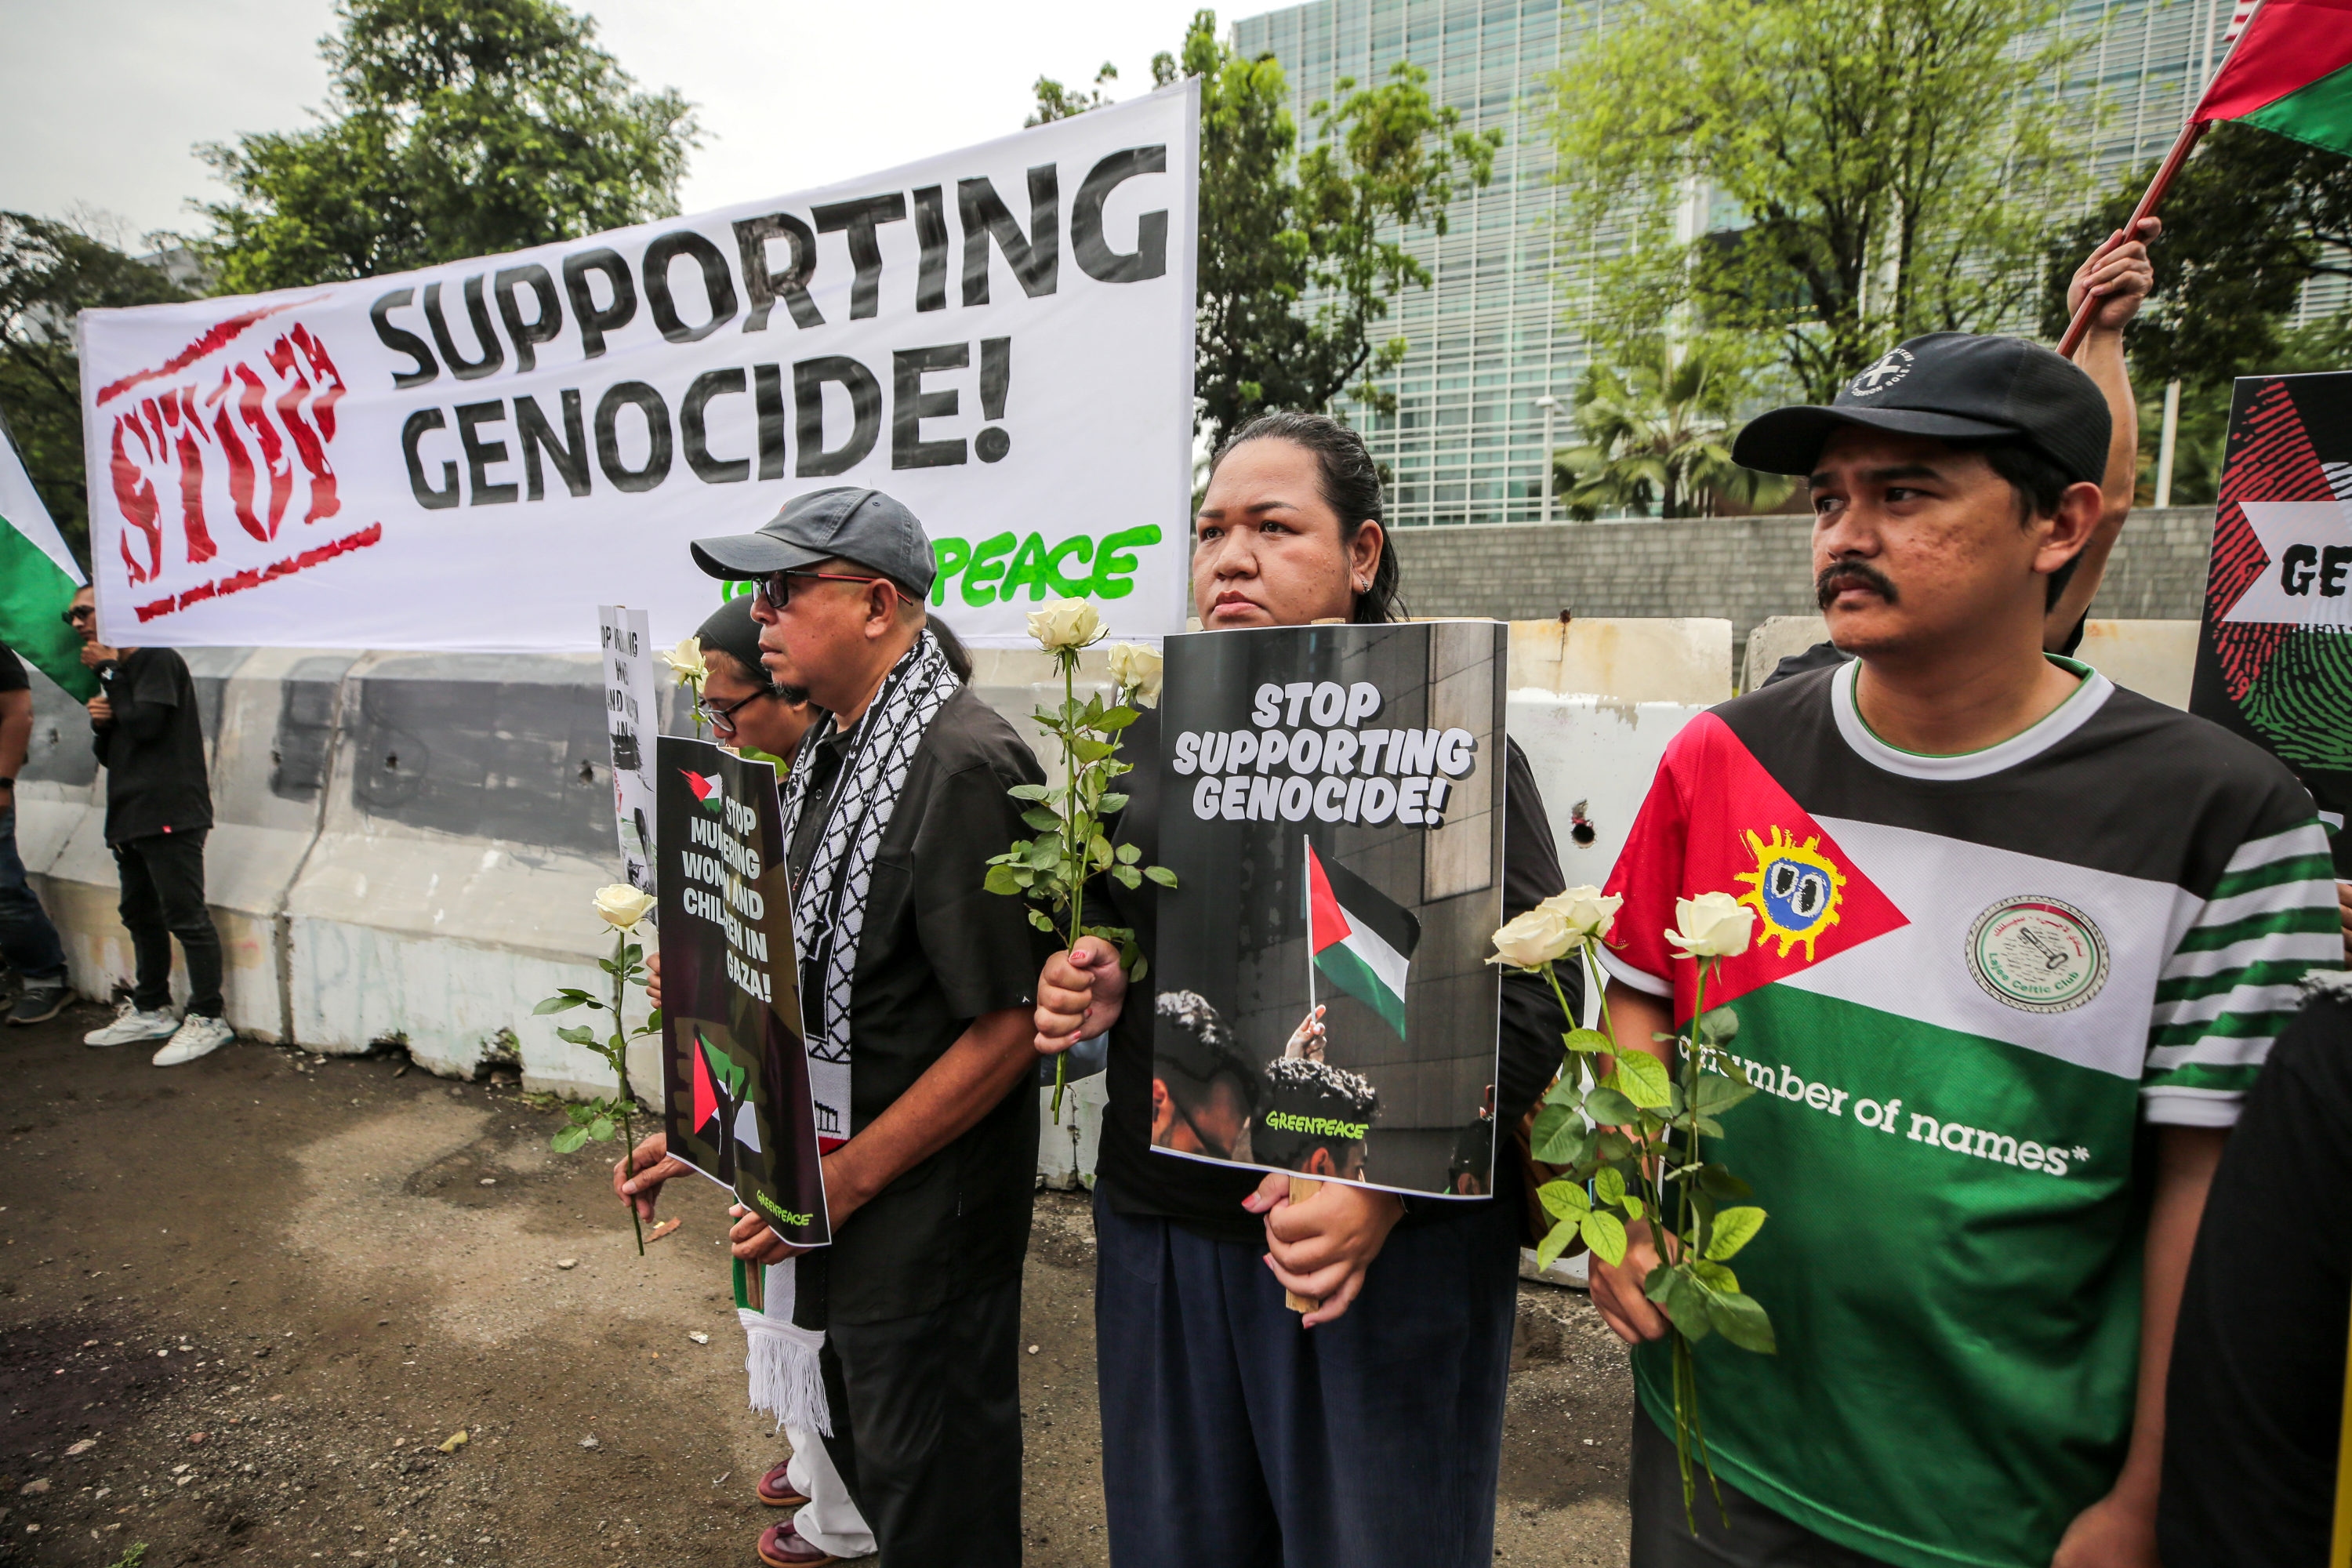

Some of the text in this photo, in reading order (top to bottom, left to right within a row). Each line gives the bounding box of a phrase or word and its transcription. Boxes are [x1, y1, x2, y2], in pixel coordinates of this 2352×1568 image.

[370, 143, 1168, 389] SUPPORTING
[401, 336, 1011, 510] GENOCIDE!
[110, 322, 347, 588] STOP
[1251, 681, 1381, 728] STOP
[1172, 728, 1474, 775] SUPPORTING
[725, 795, 757, 837] STOP
[1192, 775, 1448, 825] GENOCIDE!
[691, 816, 760, 880] MUERING
[682, 851, 764, 920] WOMN AND
[683, 887, 768, 963] CHILREN IN
[726, 949, 772, 1004] GAZA!
[1989, 952, 2080, 994] Lajee Celtic Club
[1265, 1110, 1370, 1140] GREENPEACE
[1853, 1098, 1902, 1134] of
[756, 1189, 814, 1226] GREENPEACE
